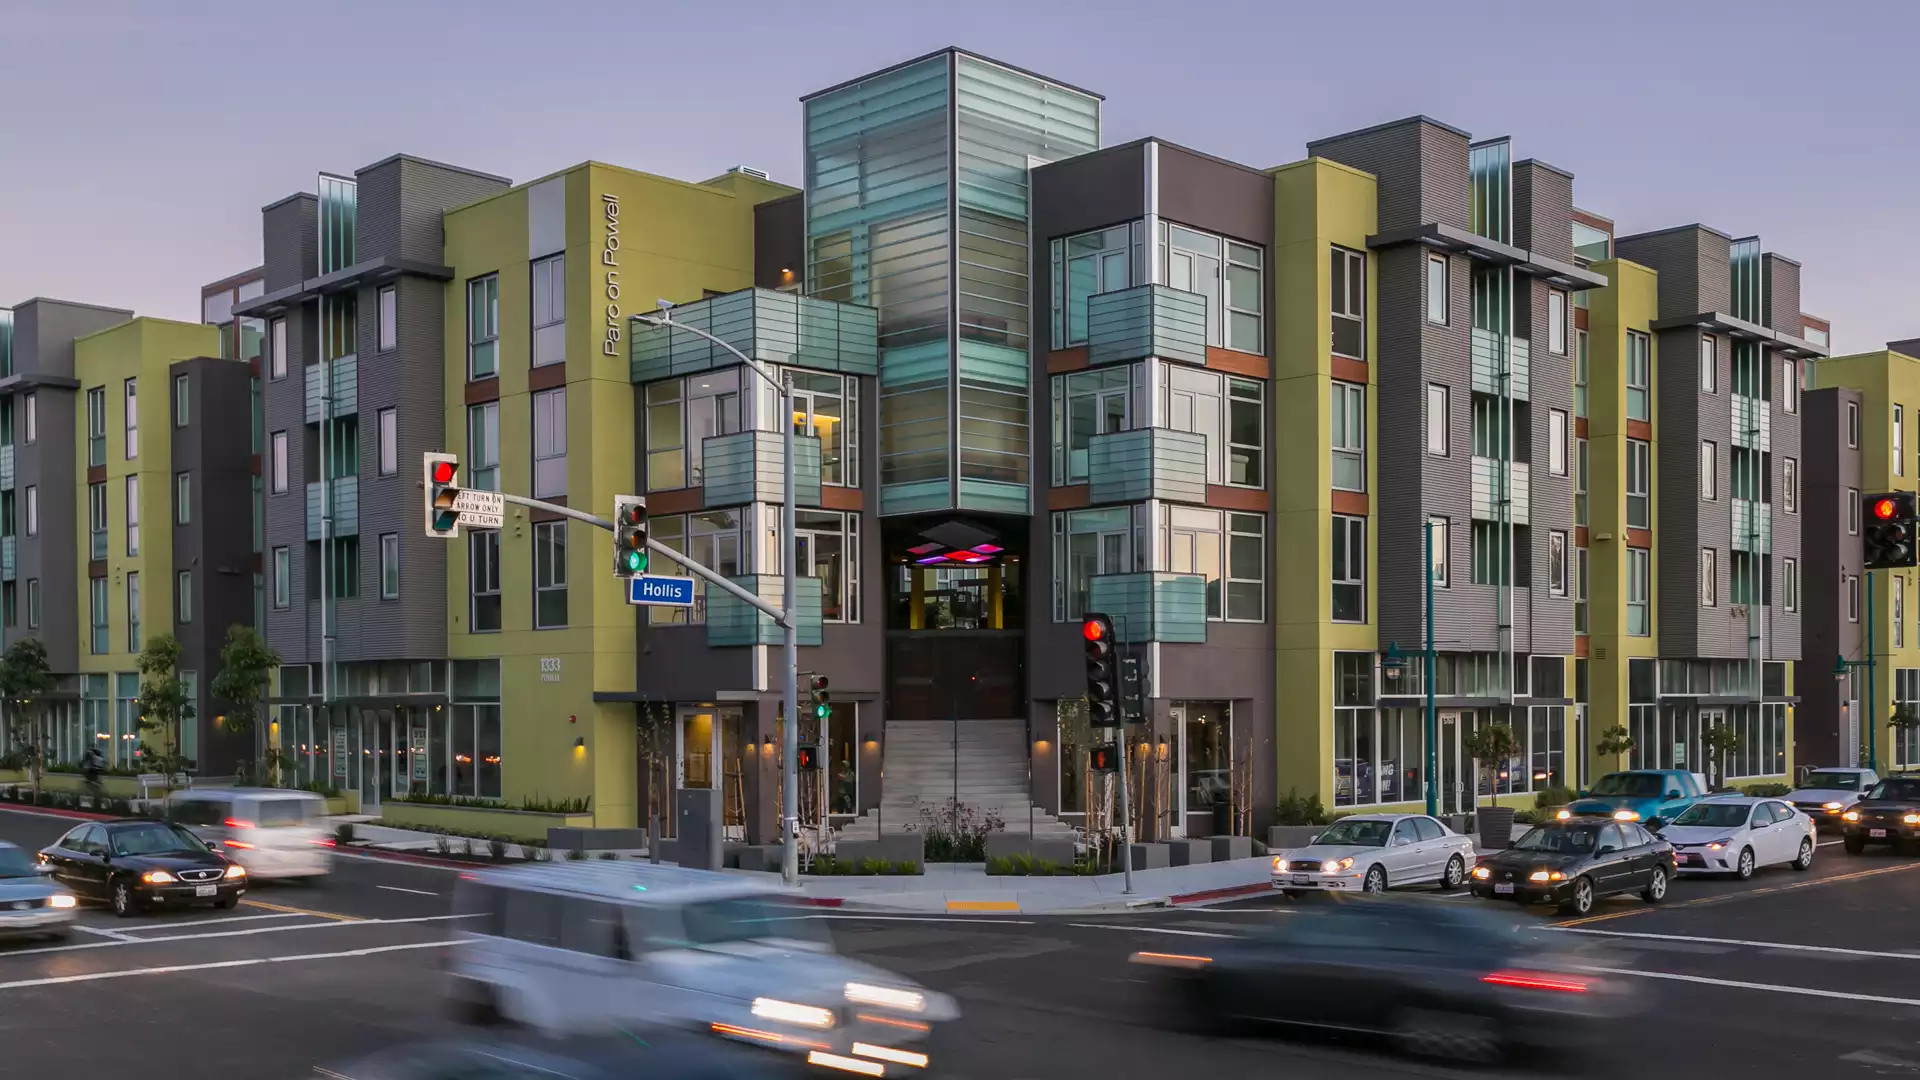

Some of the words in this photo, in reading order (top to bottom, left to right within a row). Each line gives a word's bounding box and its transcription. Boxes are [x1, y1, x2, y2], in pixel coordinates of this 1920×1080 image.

[604, 194, 620, 266] Powell
[607, 272, 620, 300] on
[604, 304, 620, 356] Parc
[473, 494, 490, 502] TURN
[492, 495, 501, 504] ON
[482, 504, 499, 513] ONLY
[479, 516, 499, 524] TURN
[643, 582, 682, 599] Hollis
[541, 657, 560, 672] 1333
